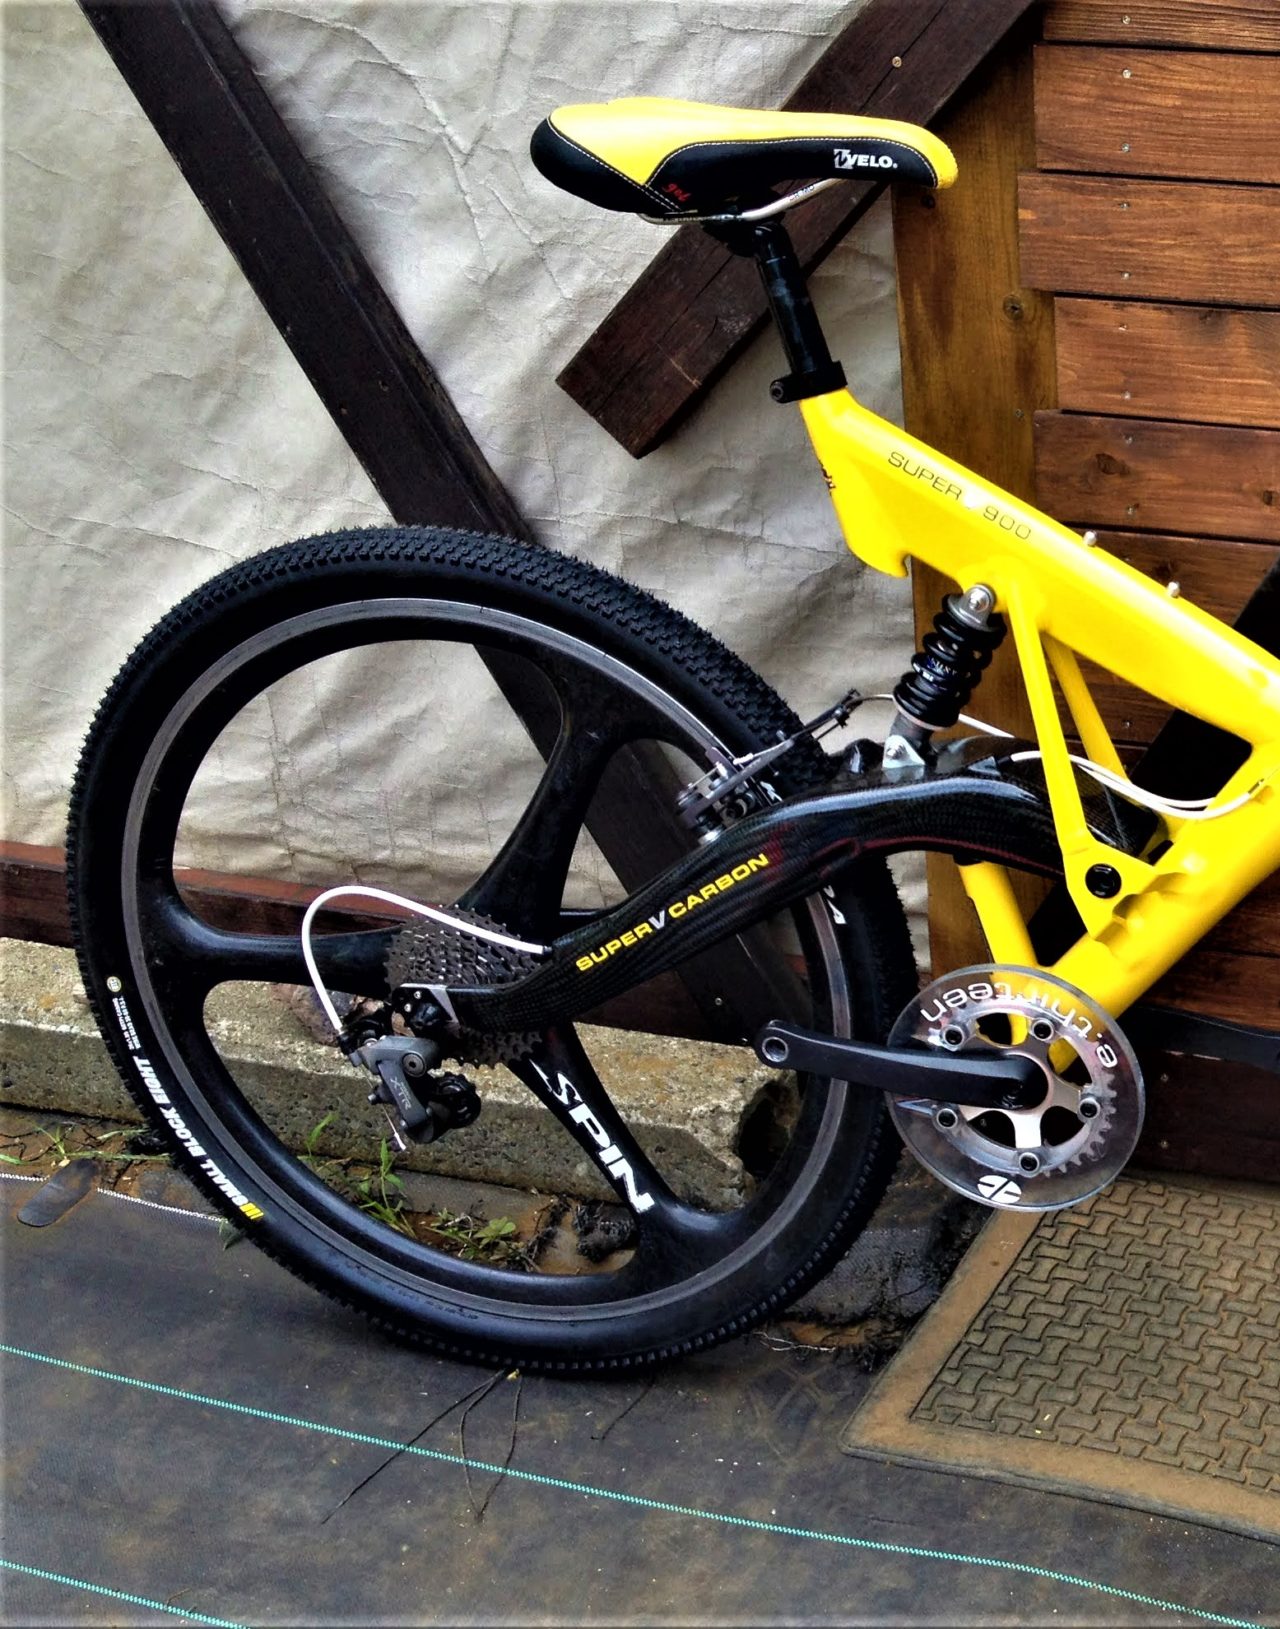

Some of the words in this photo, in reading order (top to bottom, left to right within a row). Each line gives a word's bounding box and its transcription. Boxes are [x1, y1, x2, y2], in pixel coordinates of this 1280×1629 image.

[888, 451, 962, 501] SUPER
[983, 505, 1032, 540] 900
[159, 1106, 207, 1157] BLOCK
[529, 1058, 655, 1214] SPIN
[200, 1158, 249, 1206] SMALL
